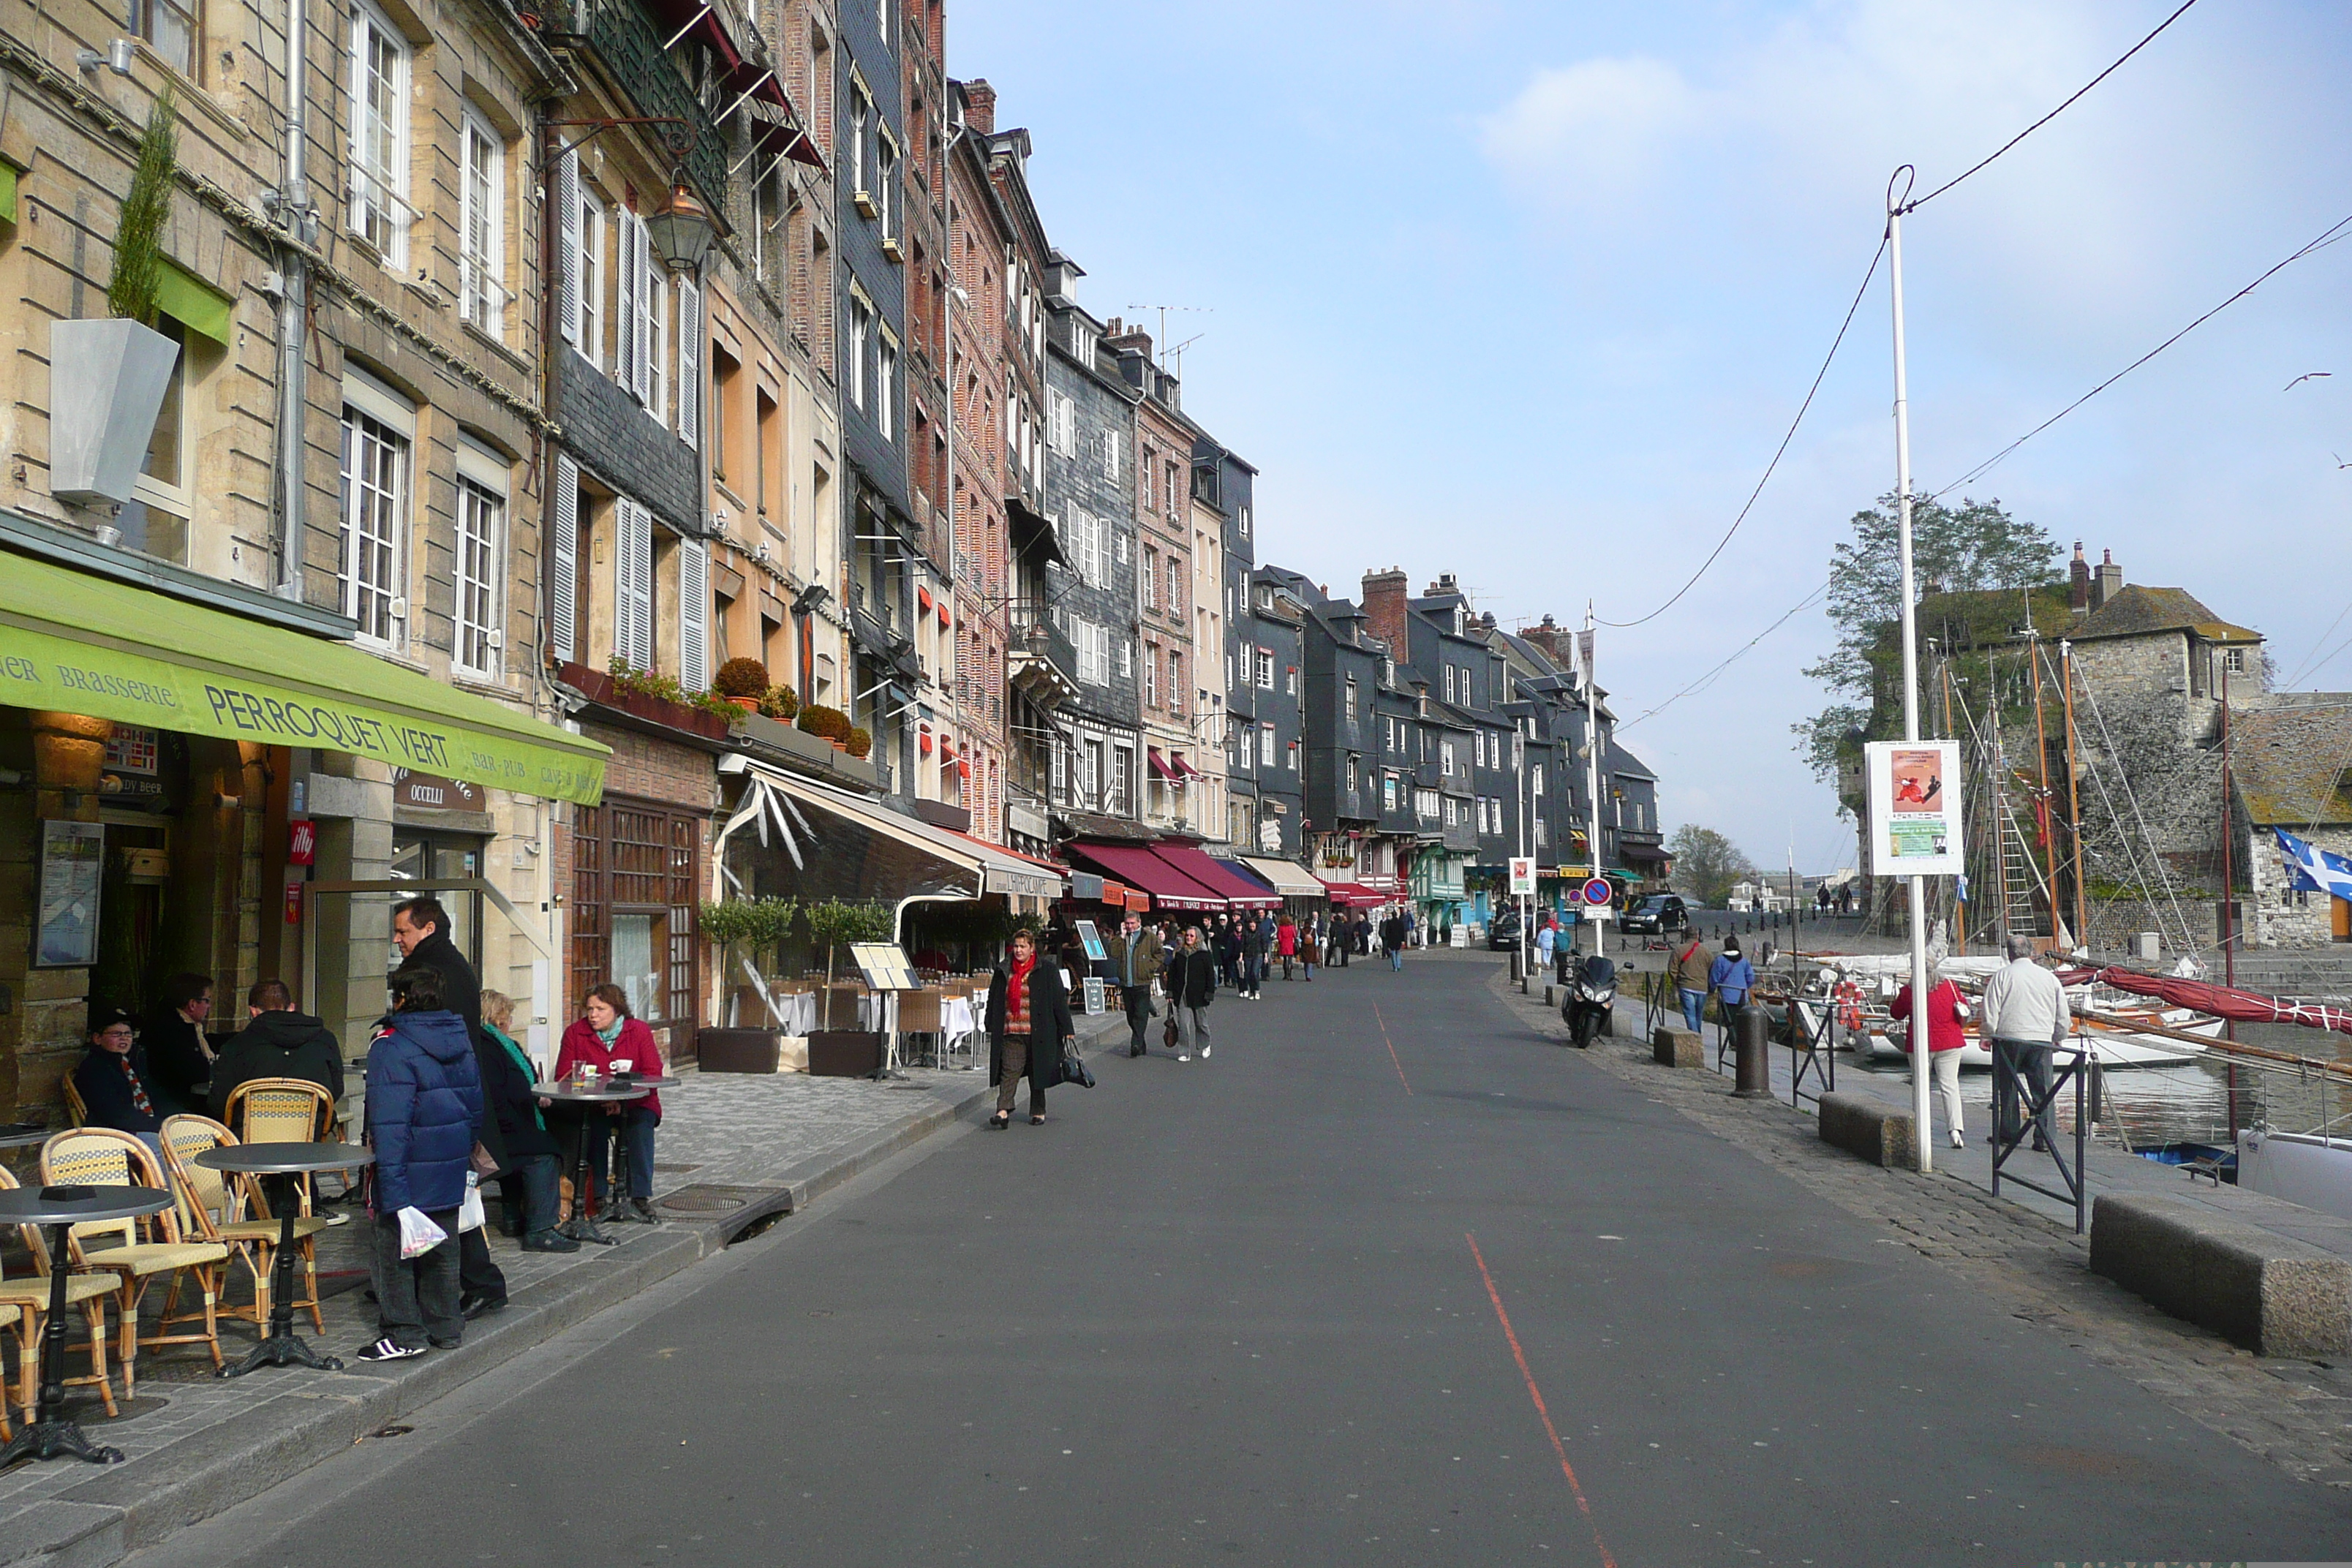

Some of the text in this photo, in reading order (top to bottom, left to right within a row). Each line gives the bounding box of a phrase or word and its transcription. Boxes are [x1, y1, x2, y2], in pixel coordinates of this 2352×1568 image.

[204, 685, 390, 754] PERROQUET
[389, 724, 450, 769] VERT
[411, 784, 443, 804] OCCELLI
[293, 825, 313, 860] illy
